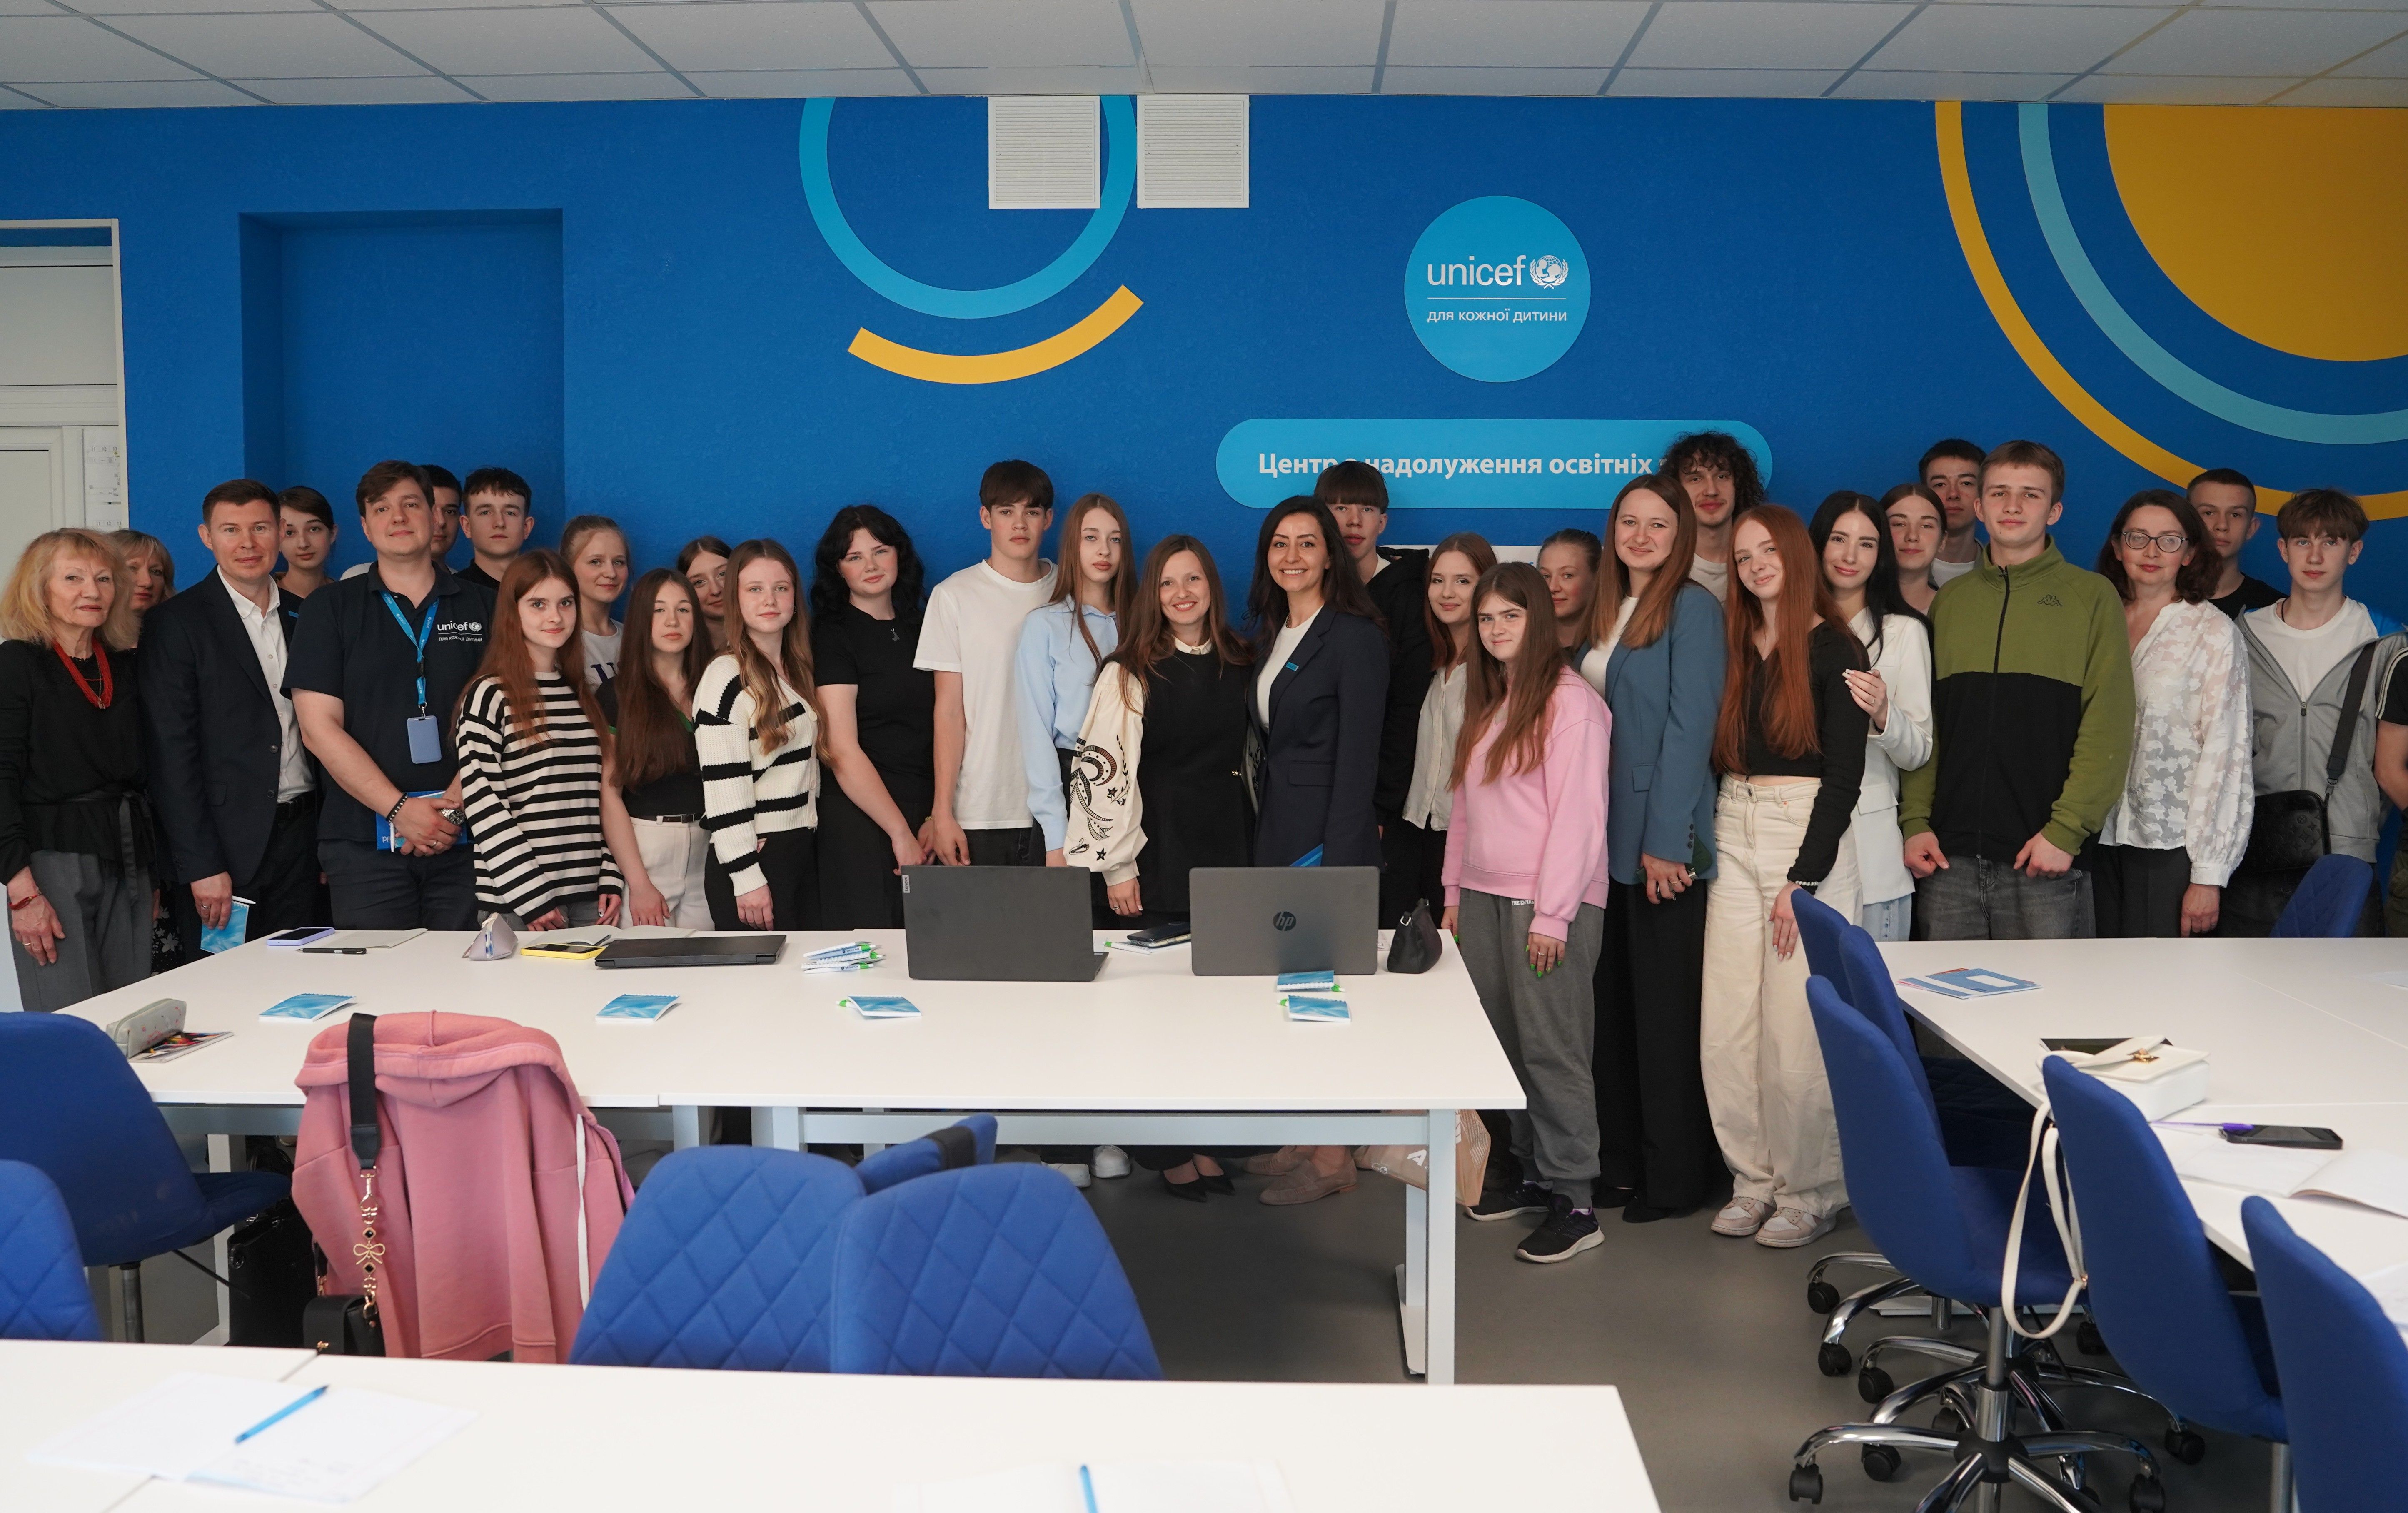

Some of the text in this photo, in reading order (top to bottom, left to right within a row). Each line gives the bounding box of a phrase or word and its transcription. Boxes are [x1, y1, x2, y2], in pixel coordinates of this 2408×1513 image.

[1427, 255, 1526, 286] unicef
[1427, 308, 1567, 323] для кожної дитини
[1549, 453, 1653, 474] освітніх
[437, 620, 468, 631] unicef
[1275, 912, 1294, 931] hp
